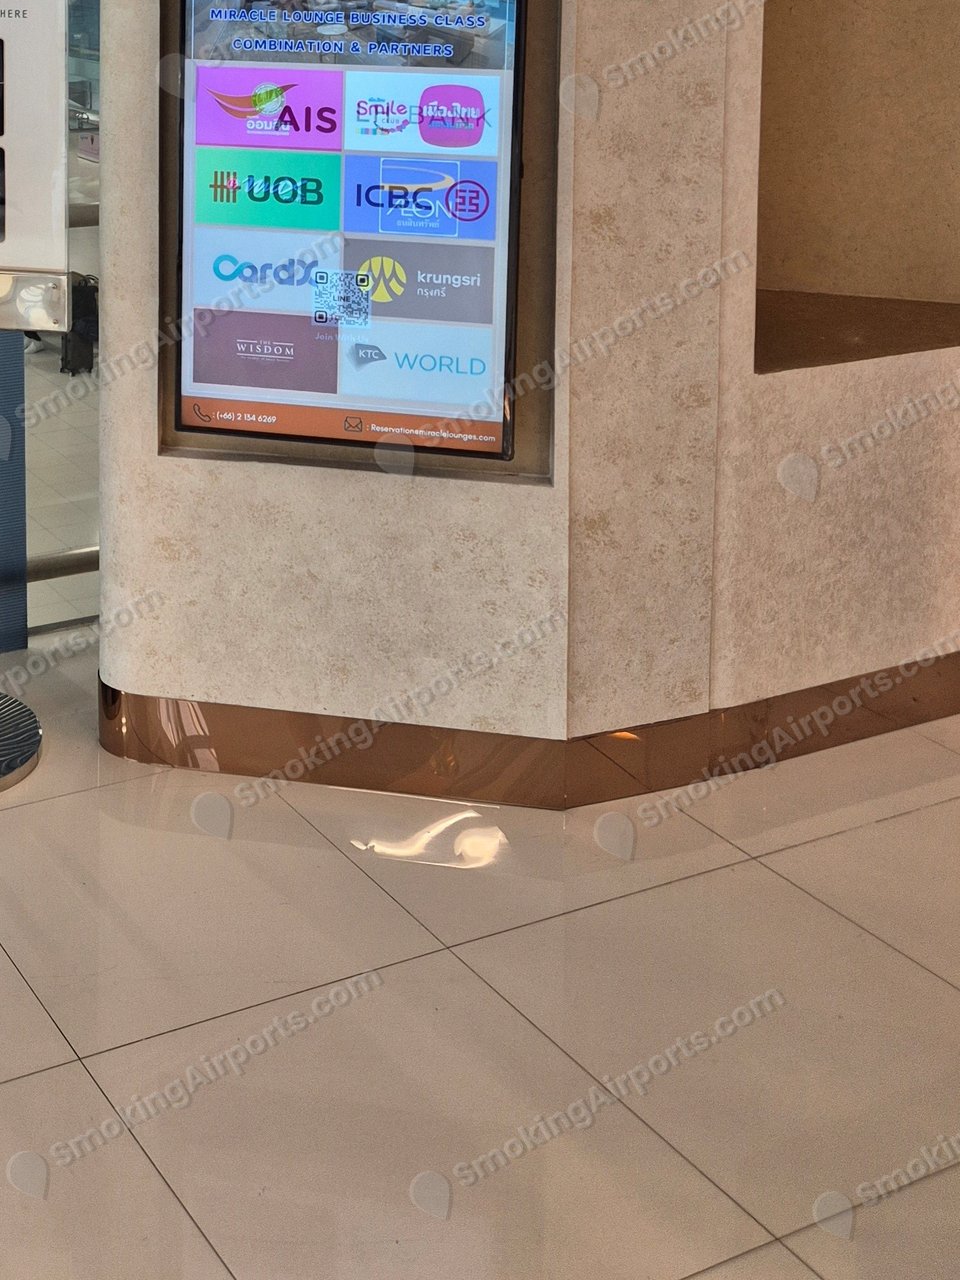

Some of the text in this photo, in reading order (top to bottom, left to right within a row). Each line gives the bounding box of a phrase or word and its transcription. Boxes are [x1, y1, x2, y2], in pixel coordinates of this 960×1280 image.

[0, 8, 29, 19] HERE
[210, 8, 486, 28] MIRACLE LOUNGE BUSINESS CLASS
[232, 38, 454, 57] COMBINATION & PARTNERS
[357, 100, 408, 116] Smile
[274, 105, 337, 134] AIS
[248, 175, 324, 205] UOB
[356, 183, 433, 211] ICBC
[417, 270, 481, 287] krungsri
[237, 343, 294, 355] WISDOM
[358, 349, 380, 359] KTC
[394, 352, 486, 376] WORLD
[216, 411, 235, 421] (+66)
[257, 415, 277, 423] 6269
